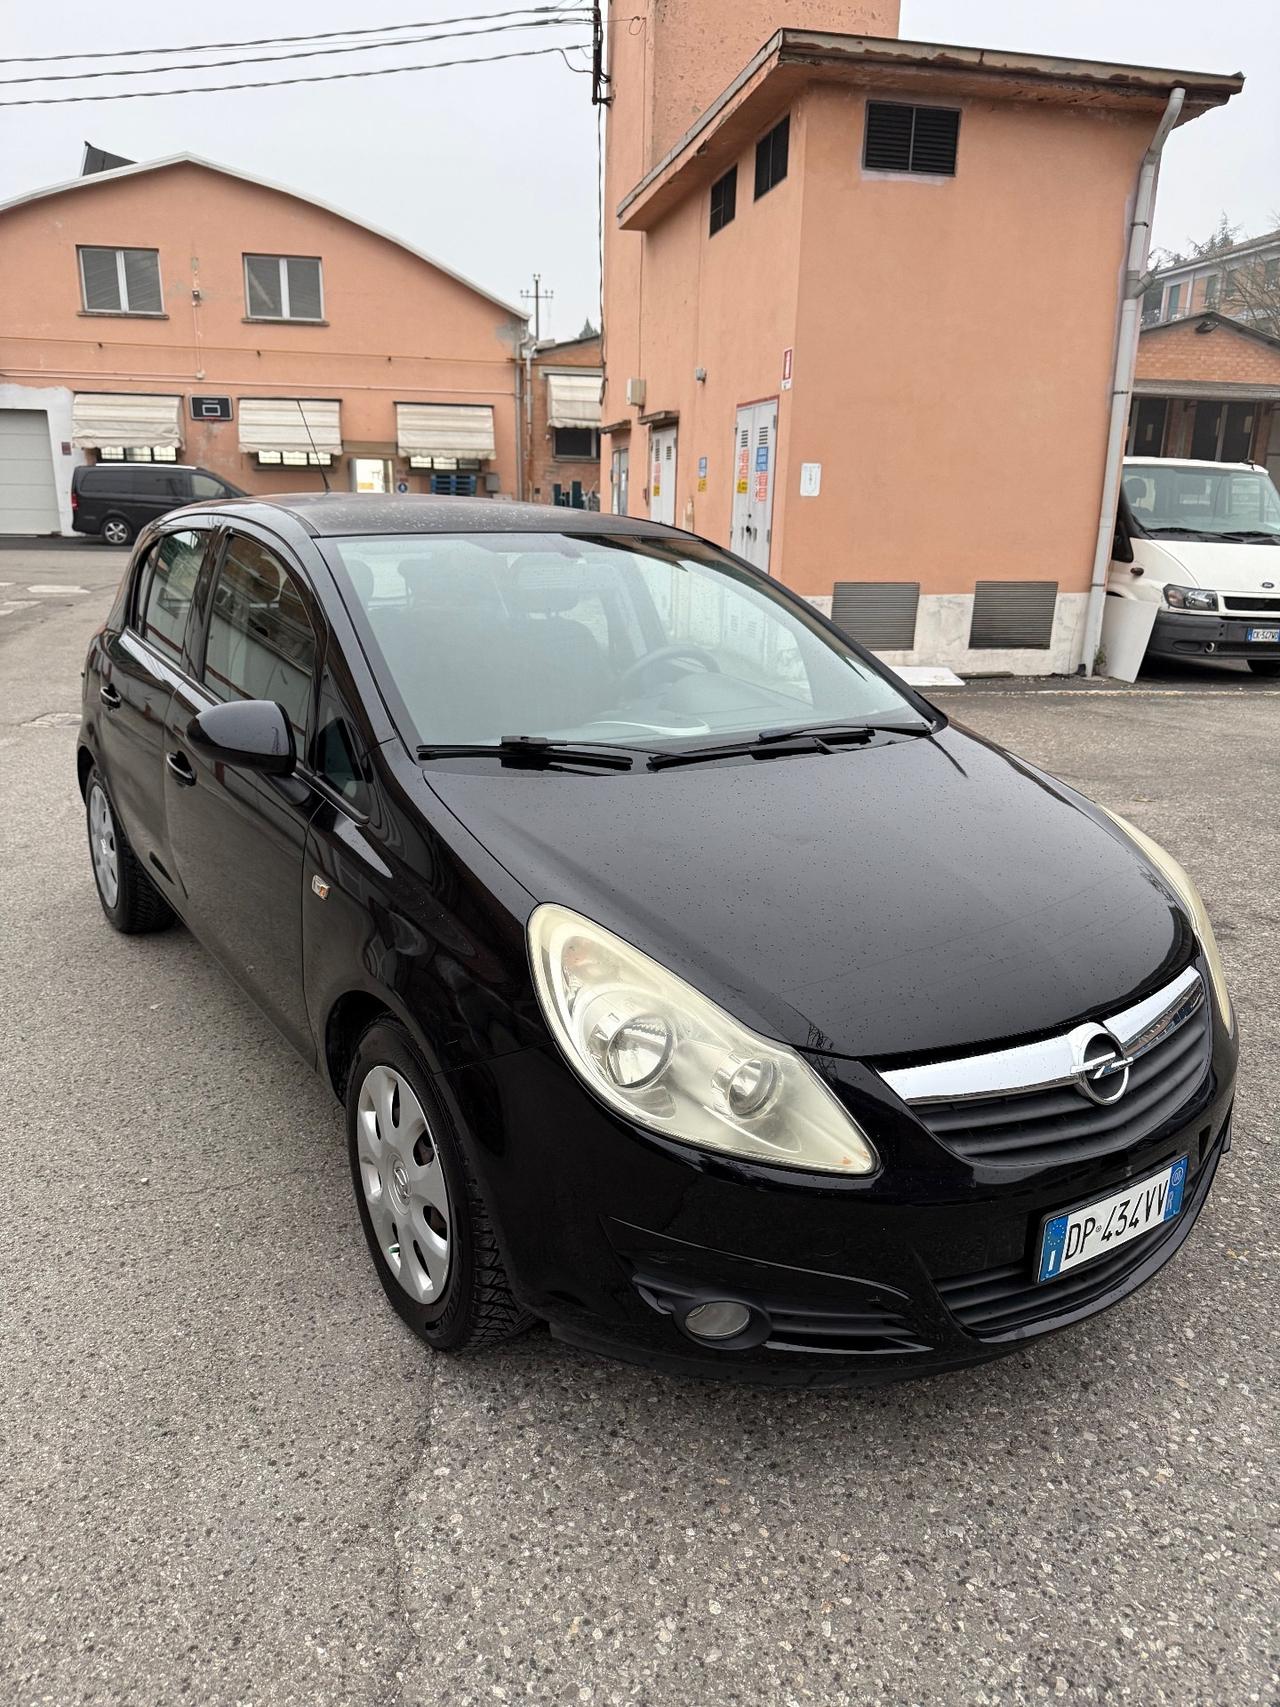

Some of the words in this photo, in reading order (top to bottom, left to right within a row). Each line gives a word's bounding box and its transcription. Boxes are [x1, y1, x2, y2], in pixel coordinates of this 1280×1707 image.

[1064, 1217, 1096, 1261] DP
[1101, 1180, 1169, 1242] 434VV
[1048, 1250, 1056, 1272] I
